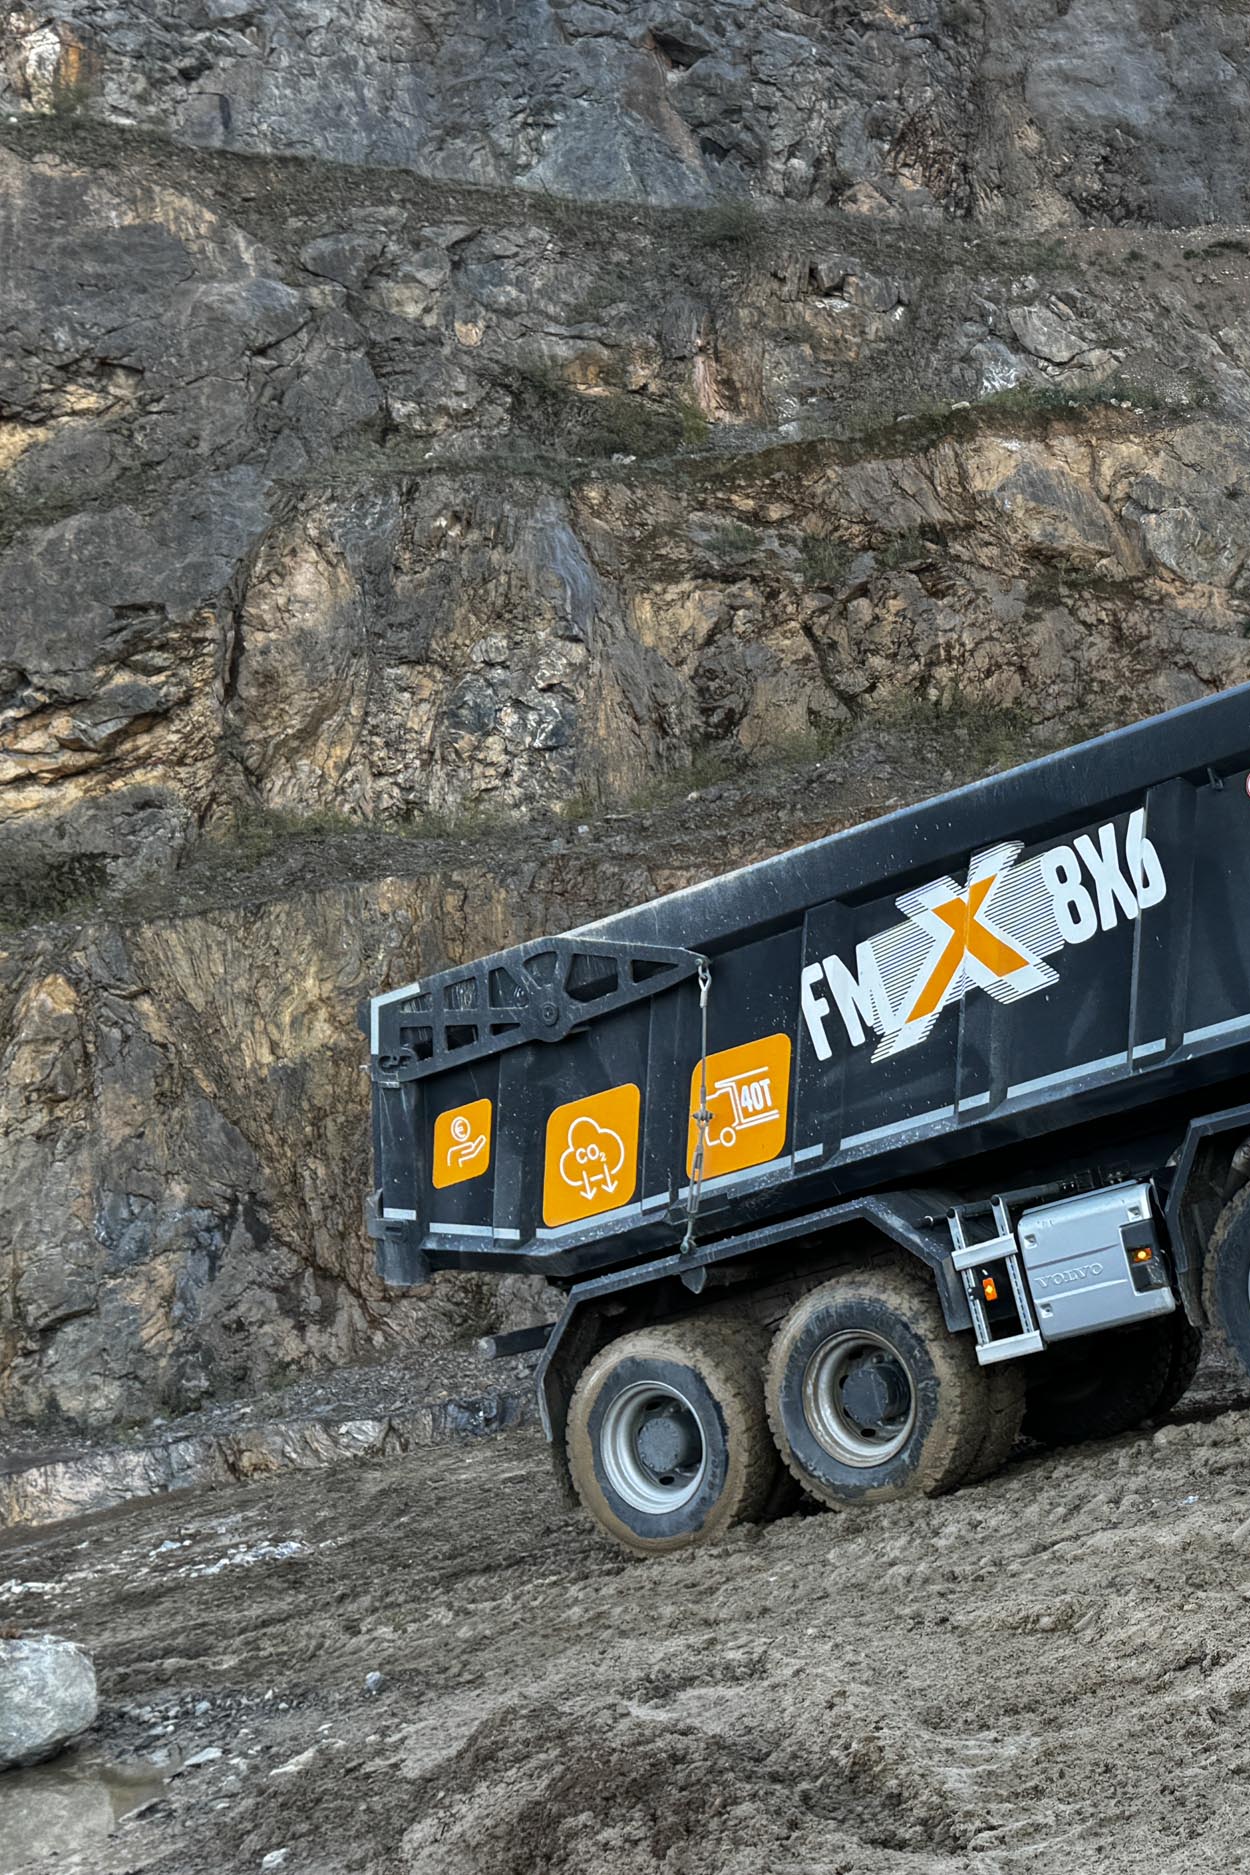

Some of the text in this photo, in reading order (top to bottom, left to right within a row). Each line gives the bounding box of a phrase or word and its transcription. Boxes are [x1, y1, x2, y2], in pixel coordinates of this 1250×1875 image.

[1039, 808, 1167, 944] 8X6
[741, 1078, 771, 1113] 40T
[1034, 1261, 1103, 1289] VOLVO
